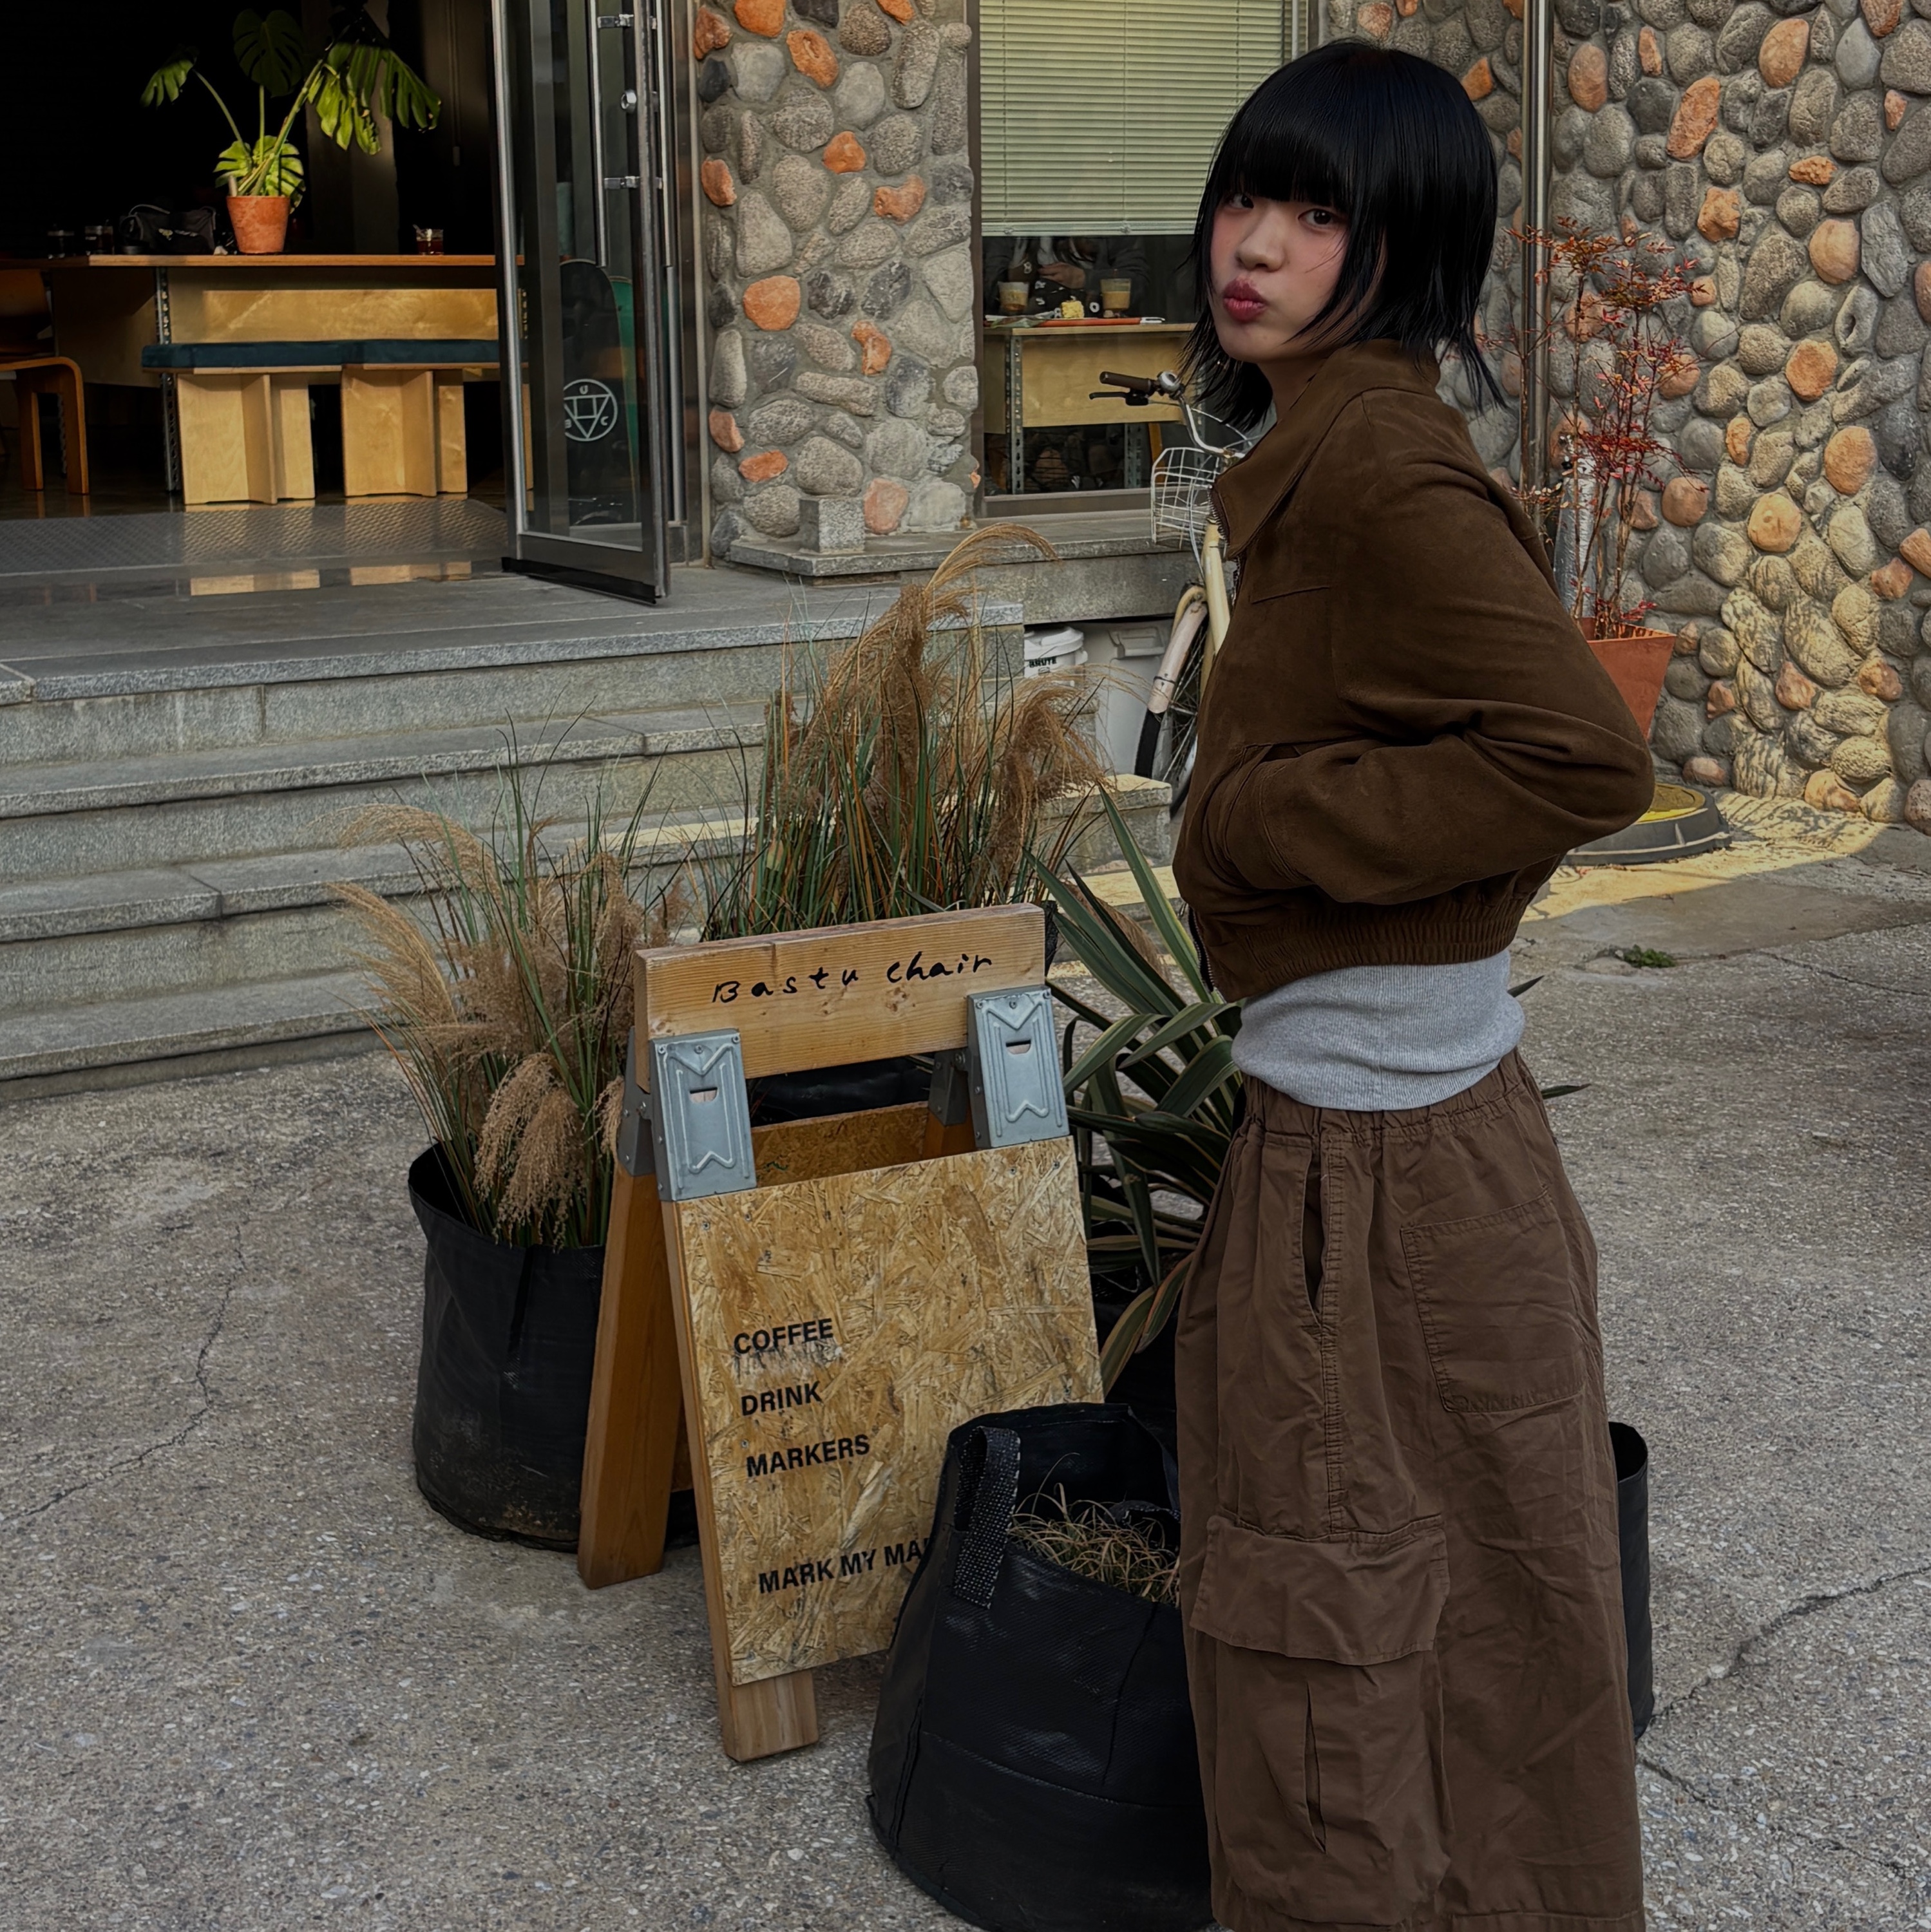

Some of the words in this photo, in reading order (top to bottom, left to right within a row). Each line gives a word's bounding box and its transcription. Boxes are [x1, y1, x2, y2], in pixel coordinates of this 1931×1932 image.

[579, 384, 589, 395] U
[712, 967, 859, 1003] Bastu
[734, 1318, 833, 1354] COFFEE
[741, 1380, 823, 1416] DRINK
[746, 1434, 870, 1477] MARKERS
[757, 1558, 835, 1594] MARK
[839, 1548, 877, 1577] MY
[884, 1537, 930, 1567] MA
